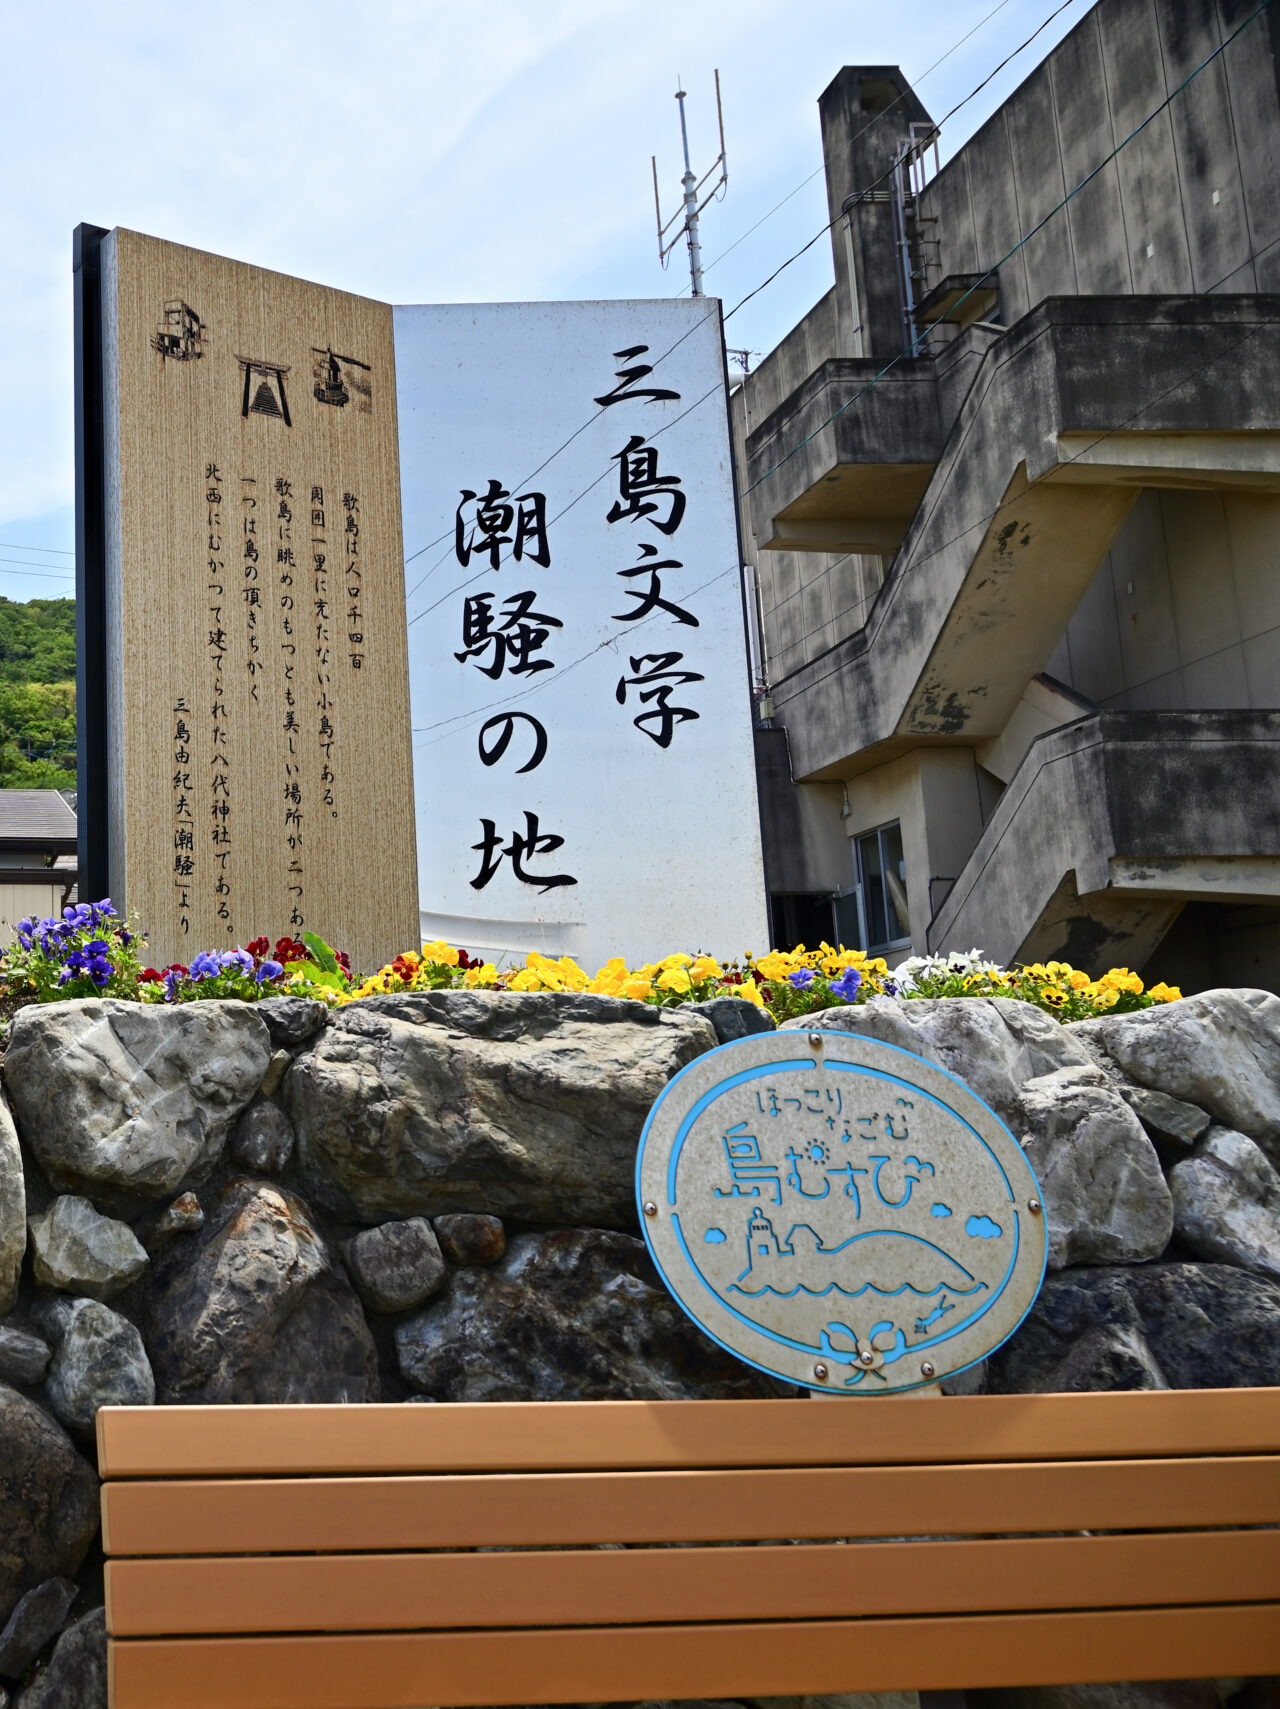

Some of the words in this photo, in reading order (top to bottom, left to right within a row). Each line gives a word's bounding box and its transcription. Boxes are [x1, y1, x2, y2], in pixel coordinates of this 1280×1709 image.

[240, 477, 263, 701] 一つは島の頂きちかく
[311, 486, 338, 818] 周囲一里に充たない小島である。
[342, 493, 365, 670] 歌島は人口千四百
[594, 344, 705, 749] 三島文学
[206, 463, 234, 933] 北西にむかつて建てられた八代神社である。
[453, 480, 579, 895] 潮騒の地
[173, 697, 195, 934] 三島由紀夫「潮騒」より
[713, 1121, 936, 1220] 島むすび
[756, 1087, 842, 1117] ほっこり
[825, 1112, 909, 1144] なごむ
